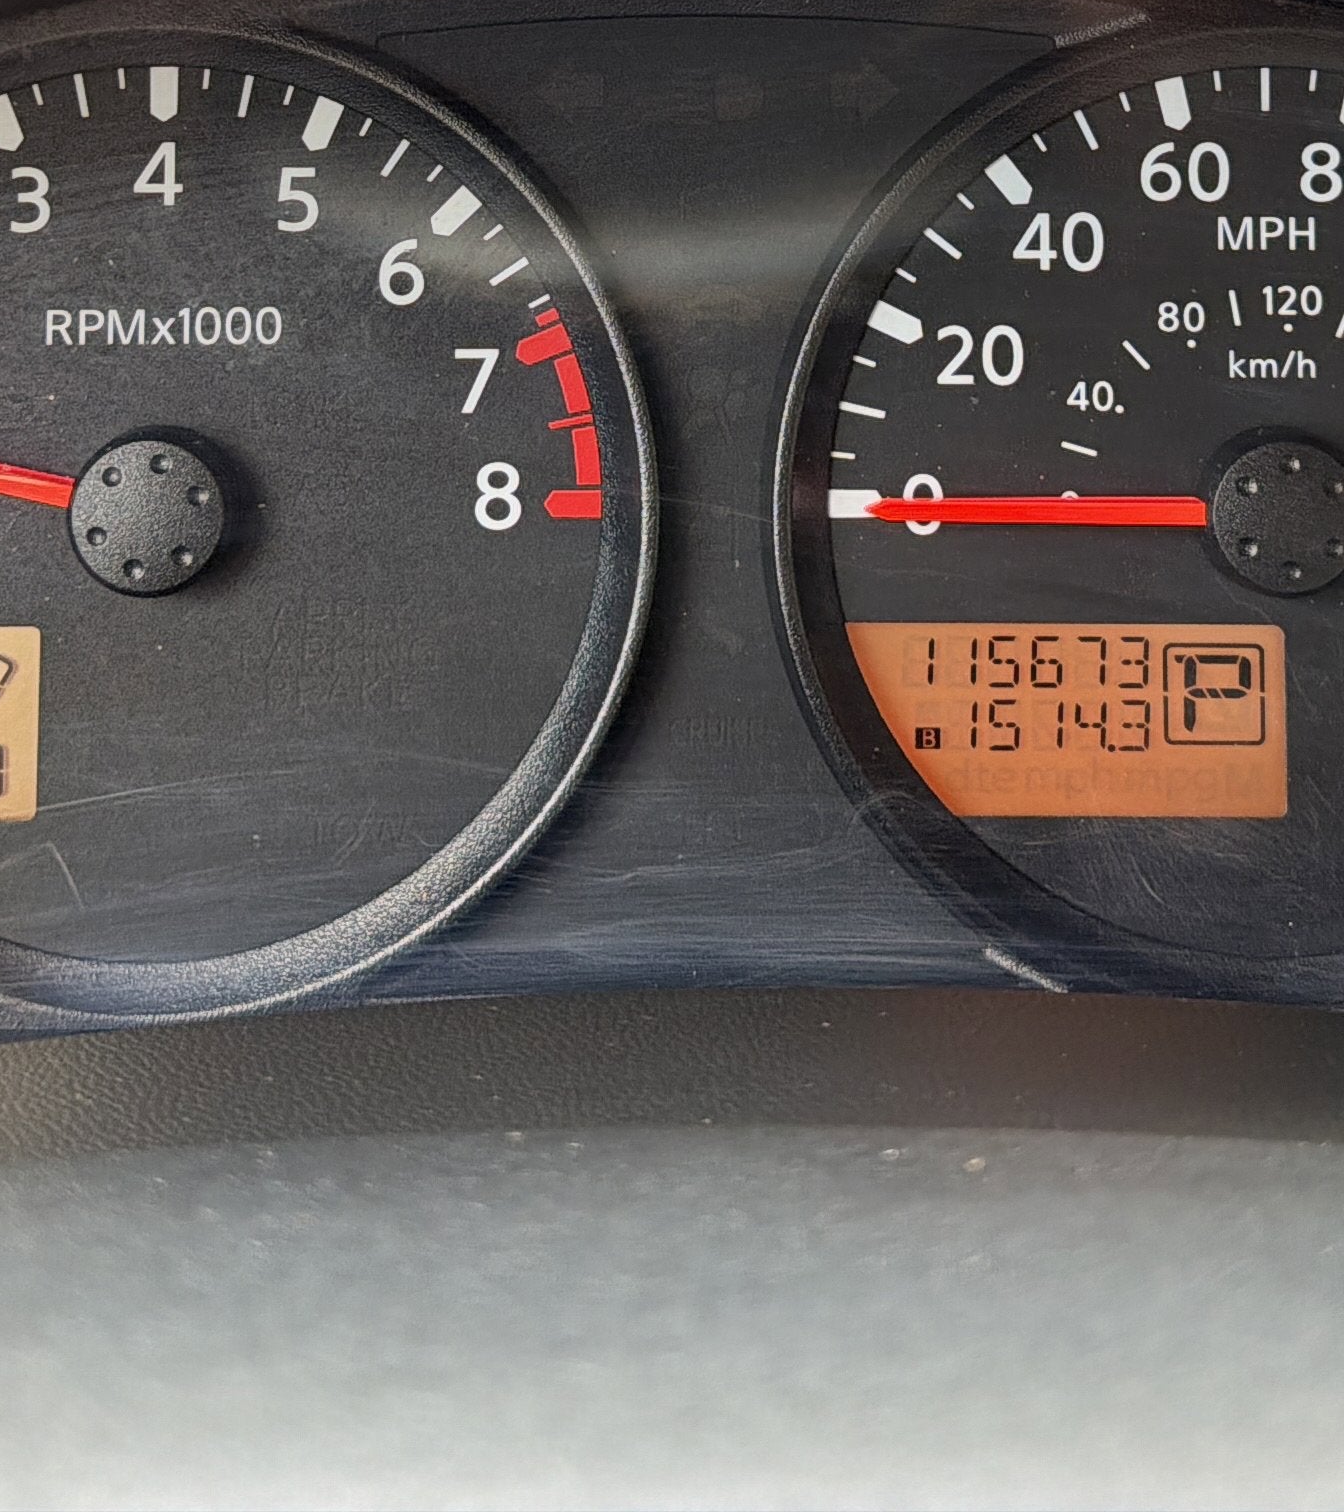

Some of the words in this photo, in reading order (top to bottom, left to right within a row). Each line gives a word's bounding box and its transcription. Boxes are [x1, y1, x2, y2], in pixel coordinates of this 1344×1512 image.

[11, 167, 50, 233] 3
[134, 142, 183, 206] 4
[278, 167, 318, 232] 5
[1141, 142, 1229, 202] 60
[1013, 212, 1103, 272] 40
[1218, 217, 1315, 250] MPH
[379, 239, 424, 305] 6
[1263, 286, 1322, 315] 120
[46, 307, 281, 345] RPMx1000
[1158, 302, 1204, 332] 80
[455, 349, 499, 413] 7
[937, 325, 1023, 386] 20
[1229, 350, 1316, 378] km/h
[1067, 381, 1112, 411] 40
[475, 462, 521, 530] 8
[926, 635, 1149, 688] 115673
[1174, 654, 1251, 732] P
[969, 699, 1150, 752] 1514.3
